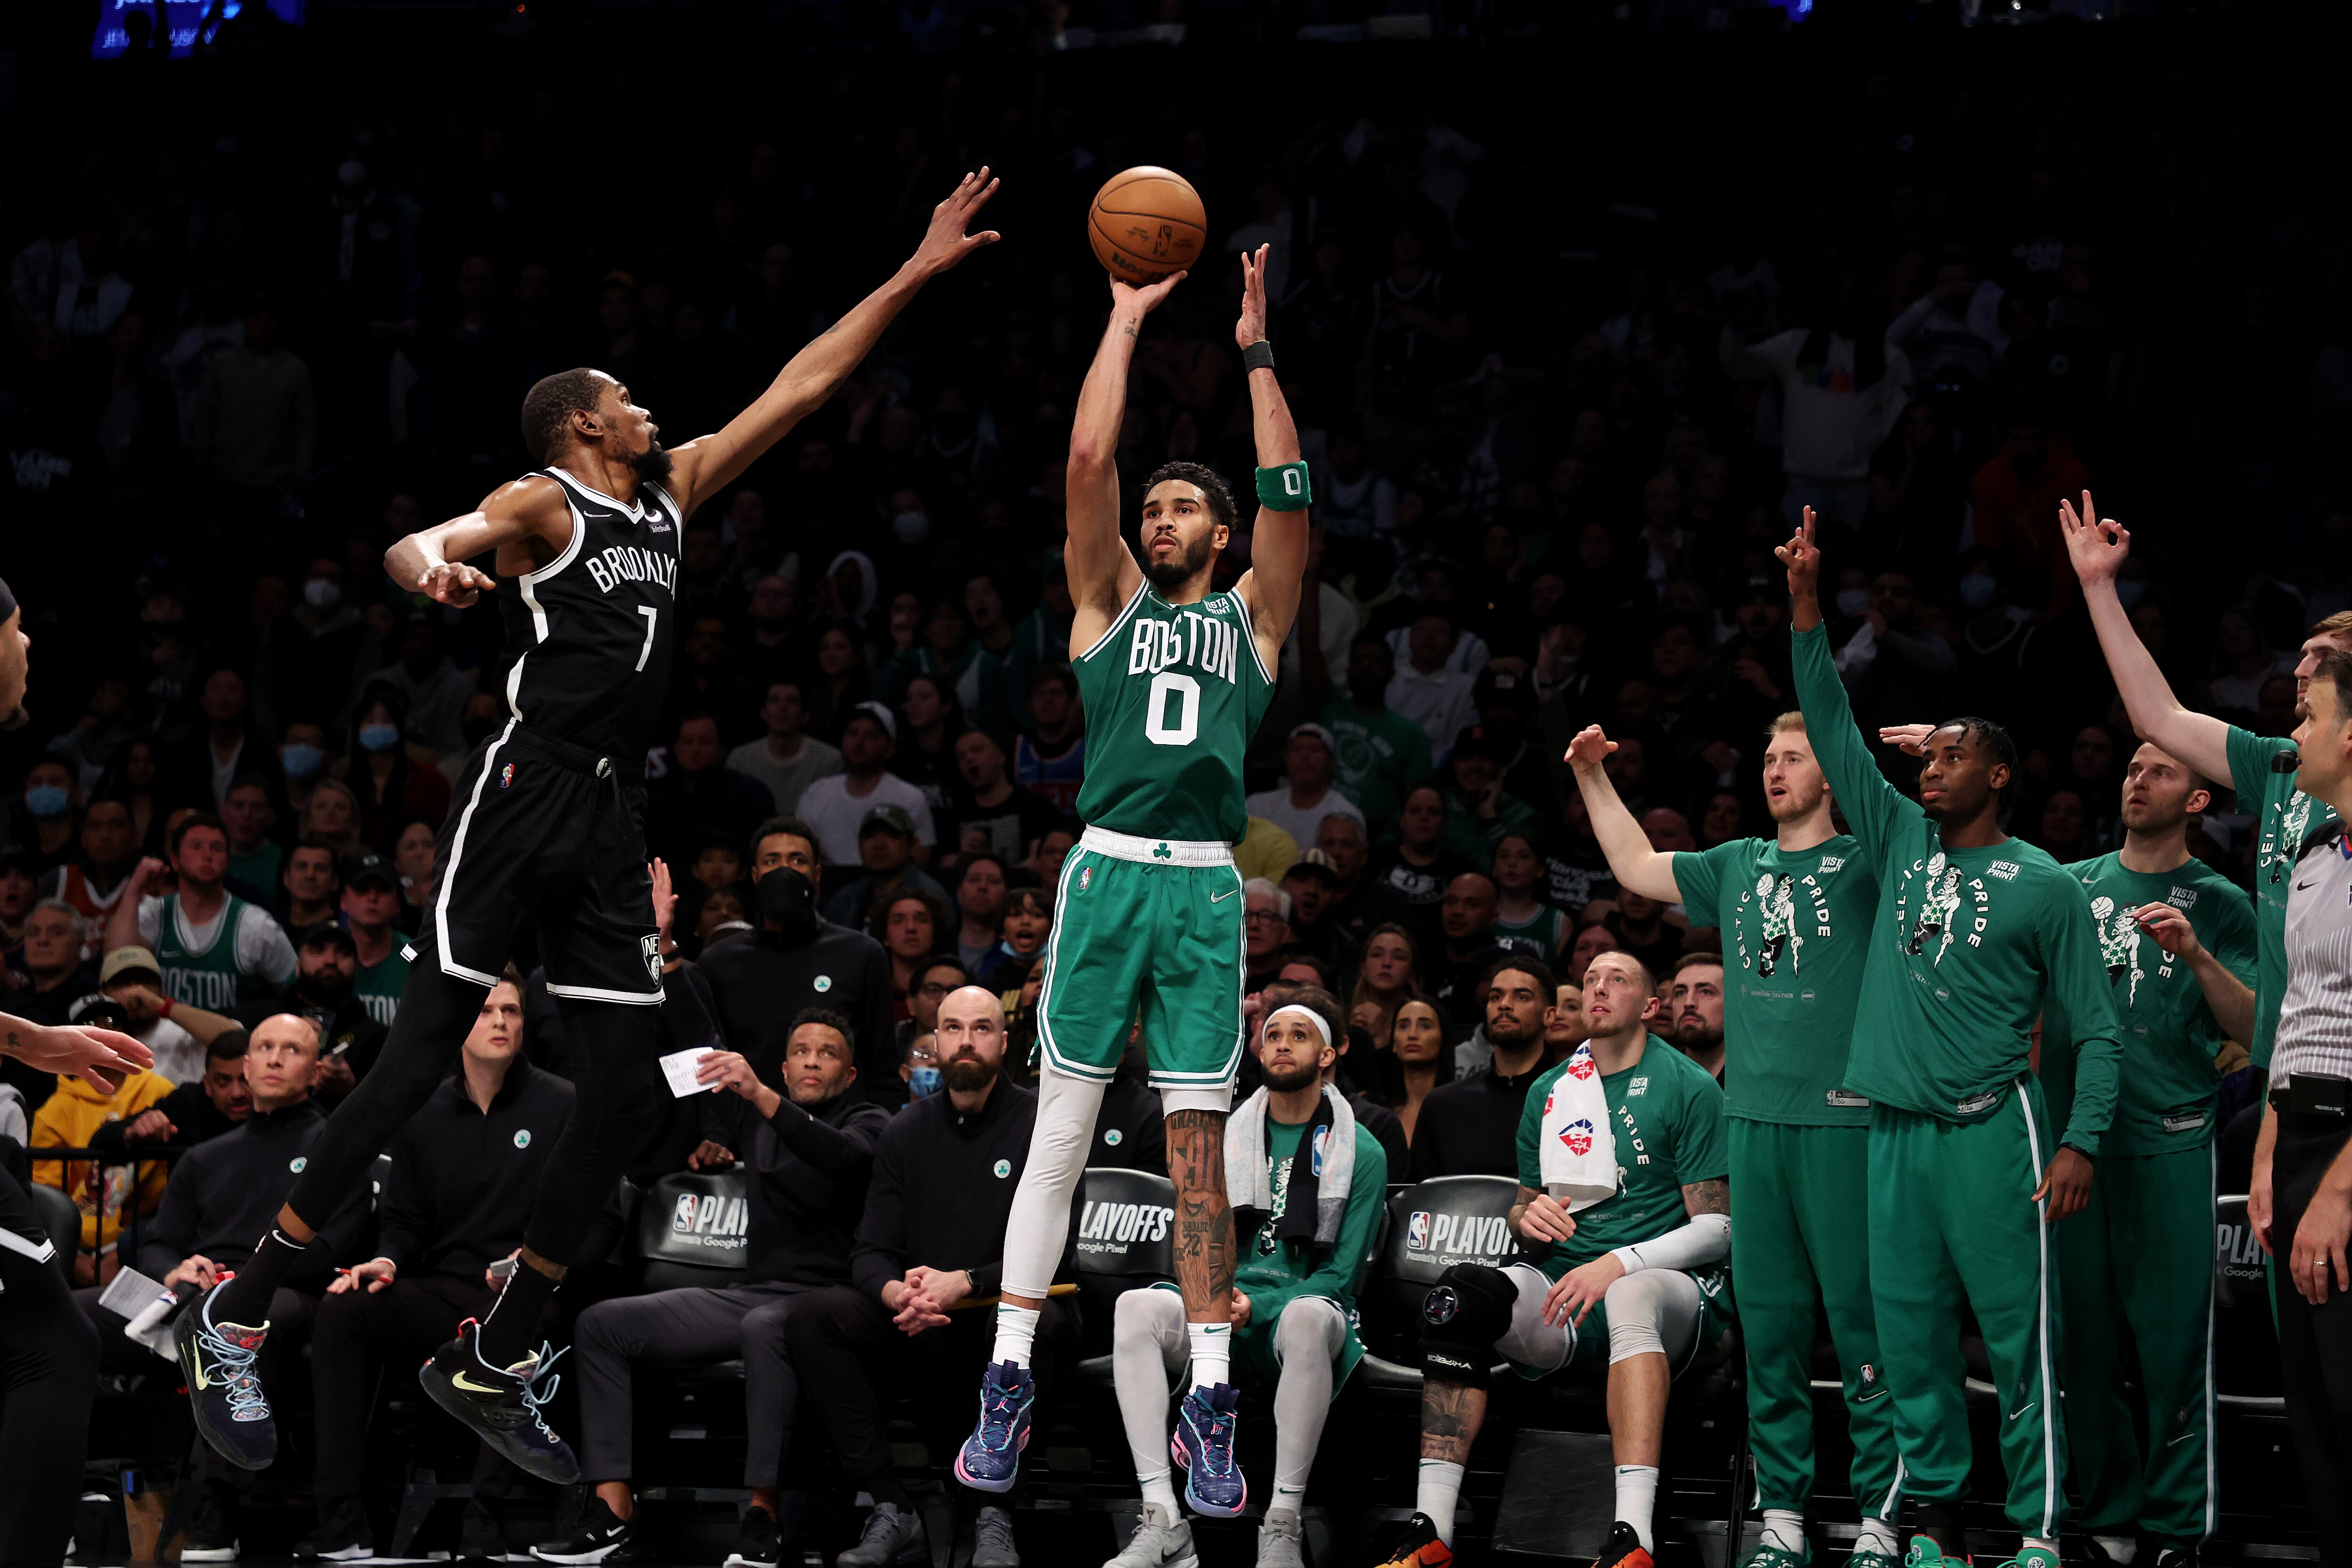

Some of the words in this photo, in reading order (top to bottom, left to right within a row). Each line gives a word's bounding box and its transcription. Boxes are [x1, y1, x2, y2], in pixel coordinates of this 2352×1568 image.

[1283, 468, 1301, 495] 0
[651, 524, 671, 533] Webull
[1203, 597, 1229, 609] VISTA
[1207, 605, 1231, 615] PRINT
[635, 605, 658, 672] 7
[1128, 611, 1238, 685] BOSTON
[1145, 671, 1200, 746] 0
[1818, 864, 1843, 874] PRINT
[1991, 860, 2020, 874] VISTA
[1986, 868, 2016, 881] PRINT
[2171, 886, 2198, 900] VISTA
[1801, 874, 1831, 937] PRIDE
[2166, 897, 2195, 909] PRINT
[1967, 878, 1989, 948] PRIDE
[1735, 891, 1751, 970] CELTIC
[1618, 1105, 1650, 1165] PRIDE
[1429, 1214, 1529, 1255] PLAYO
[703, 1236, 739, 1250] Google
[1077, 1242, 1104, 1254] oogle
[1105, 1243, 1128, 1254] Pixel
[1184, 1234, 1200, 1256] 22
[1477, 1258, 1500, 1267] Pixel
[2224, 1266, 2264, 1280] Google
